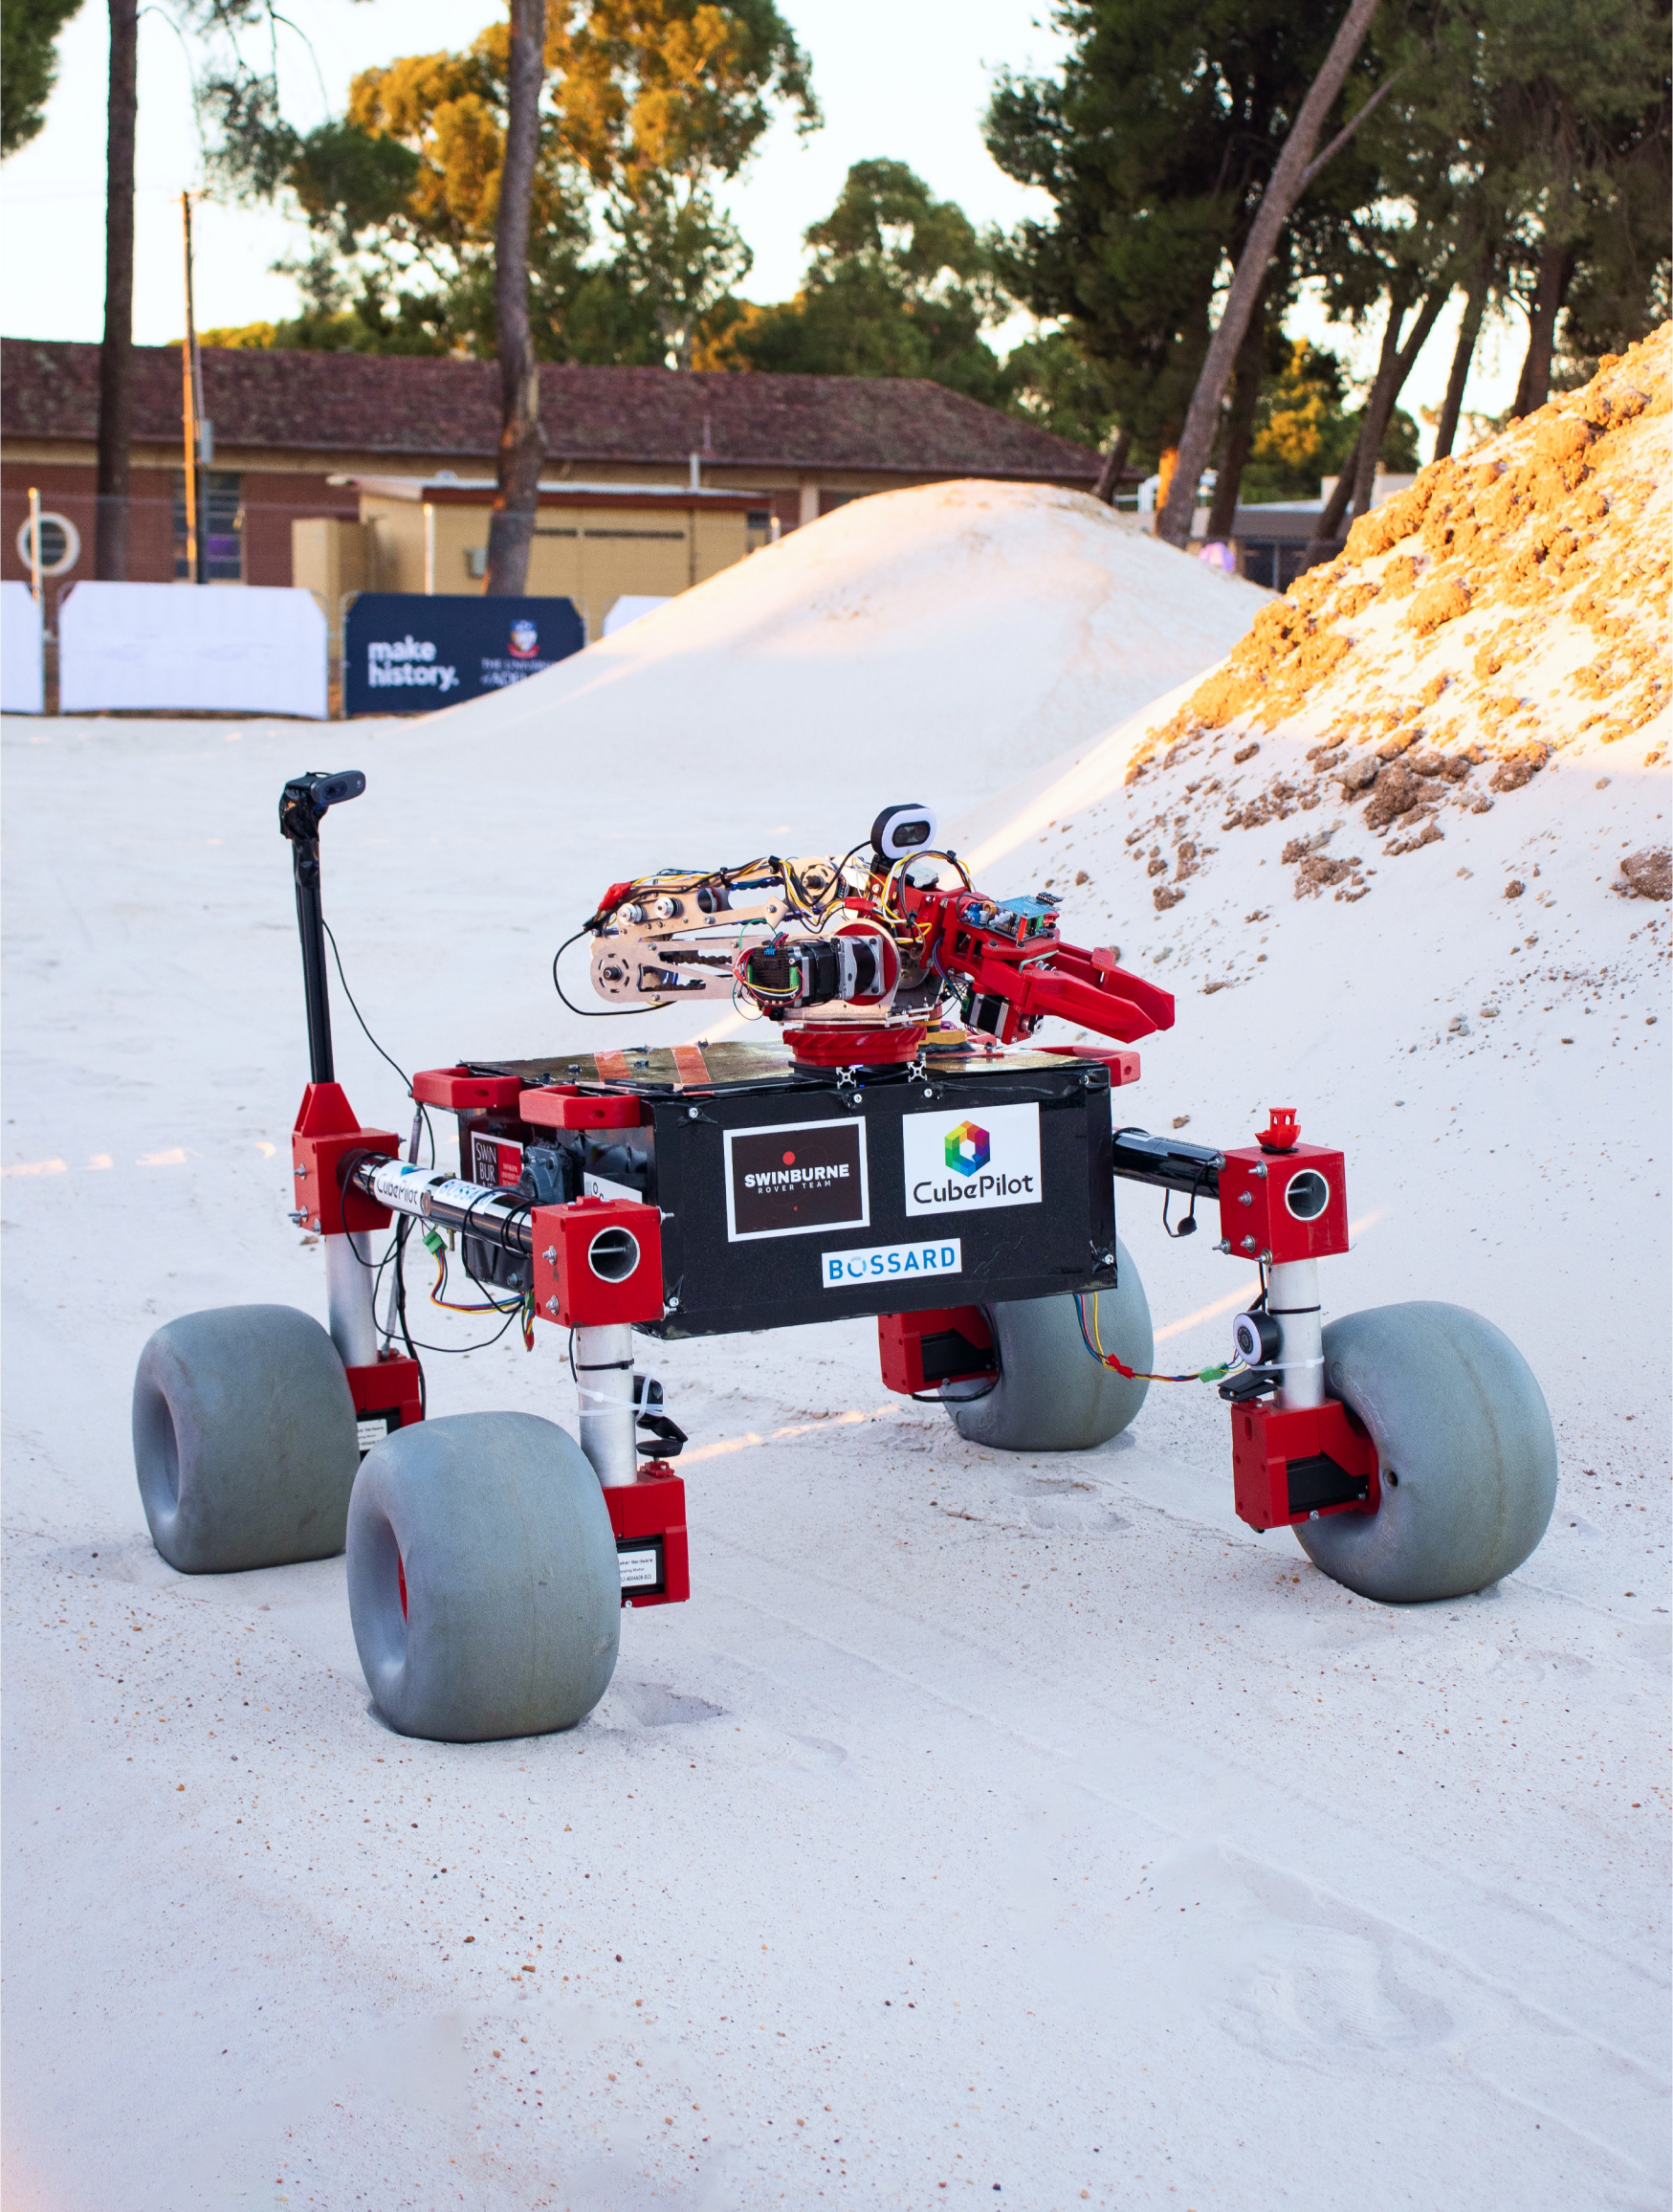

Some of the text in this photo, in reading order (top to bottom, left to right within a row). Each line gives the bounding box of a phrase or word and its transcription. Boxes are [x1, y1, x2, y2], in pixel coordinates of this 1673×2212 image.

[368, 634, 437, 662] make
[368, 659, 459, 692] history.
[476, 1142, 496, 1164] SWIN
[479, 1162, 495, 1183] BUR
[744, 1163, 849, 1187] SWINBURNE
[377, 1174, 418, 1205] CubePilot
[758, 1180, 832, 1195] ROVER TEAM
[914, 1174, 1034, 1204] CubePilot
[829, 1247, 955, 1280] BOSSARD
